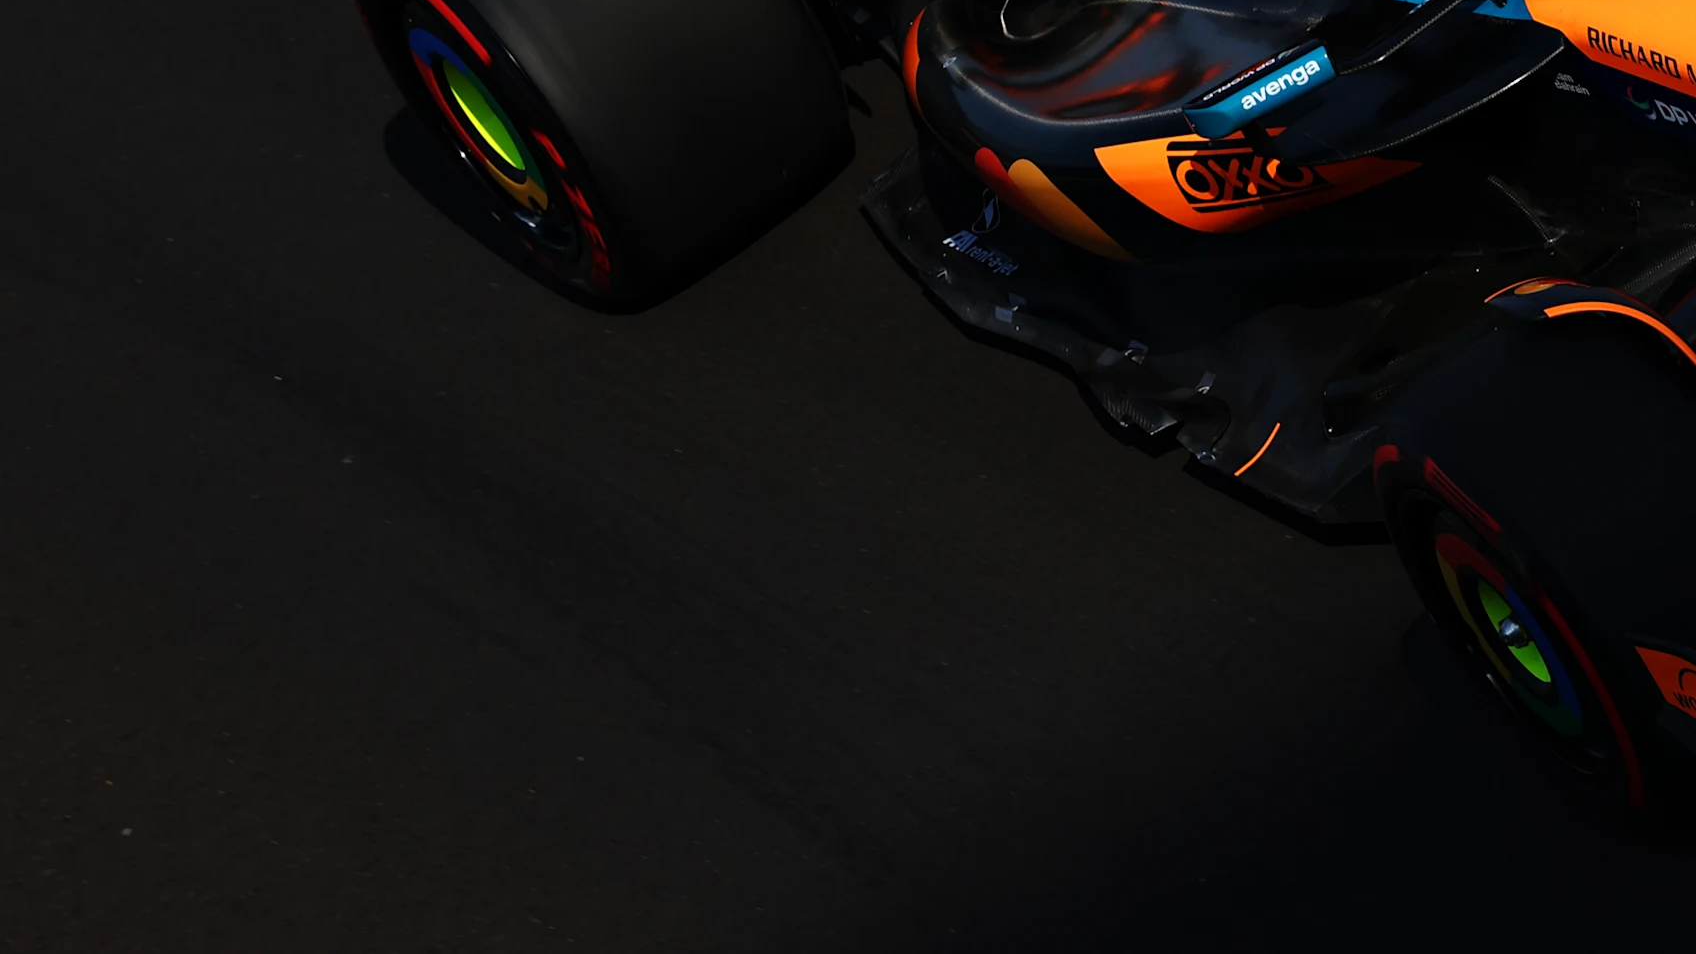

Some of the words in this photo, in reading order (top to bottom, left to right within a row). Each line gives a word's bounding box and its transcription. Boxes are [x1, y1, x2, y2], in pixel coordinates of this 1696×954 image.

[1588, 26, 1681, 80] RICHARD
[1241, 59, 1321, 111] avenga
[1654, 99, 1689, 126] DP
[1176, 155, 1315, 201] OXXO
